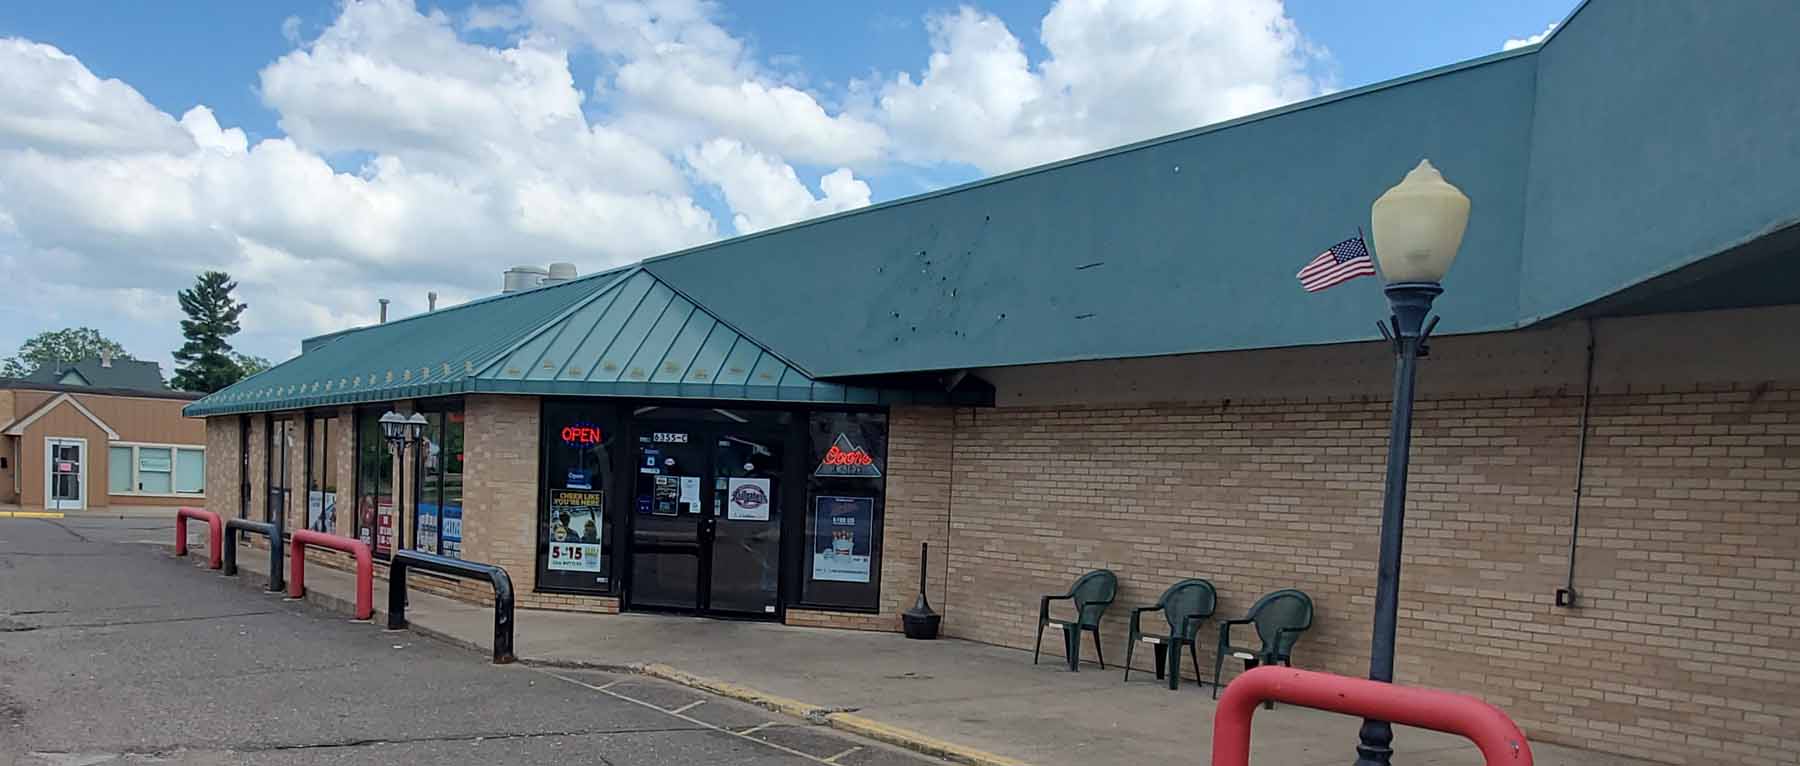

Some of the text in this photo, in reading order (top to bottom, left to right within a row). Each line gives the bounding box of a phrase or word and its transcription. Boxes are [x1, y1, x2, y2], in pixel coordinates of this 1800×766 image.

[562, 427, 600, 443] OPEN
[654, 433, 687, 442] 6355-C
[823, 446, 872, 465] Coors
[552, 546, 560, 558] 5
